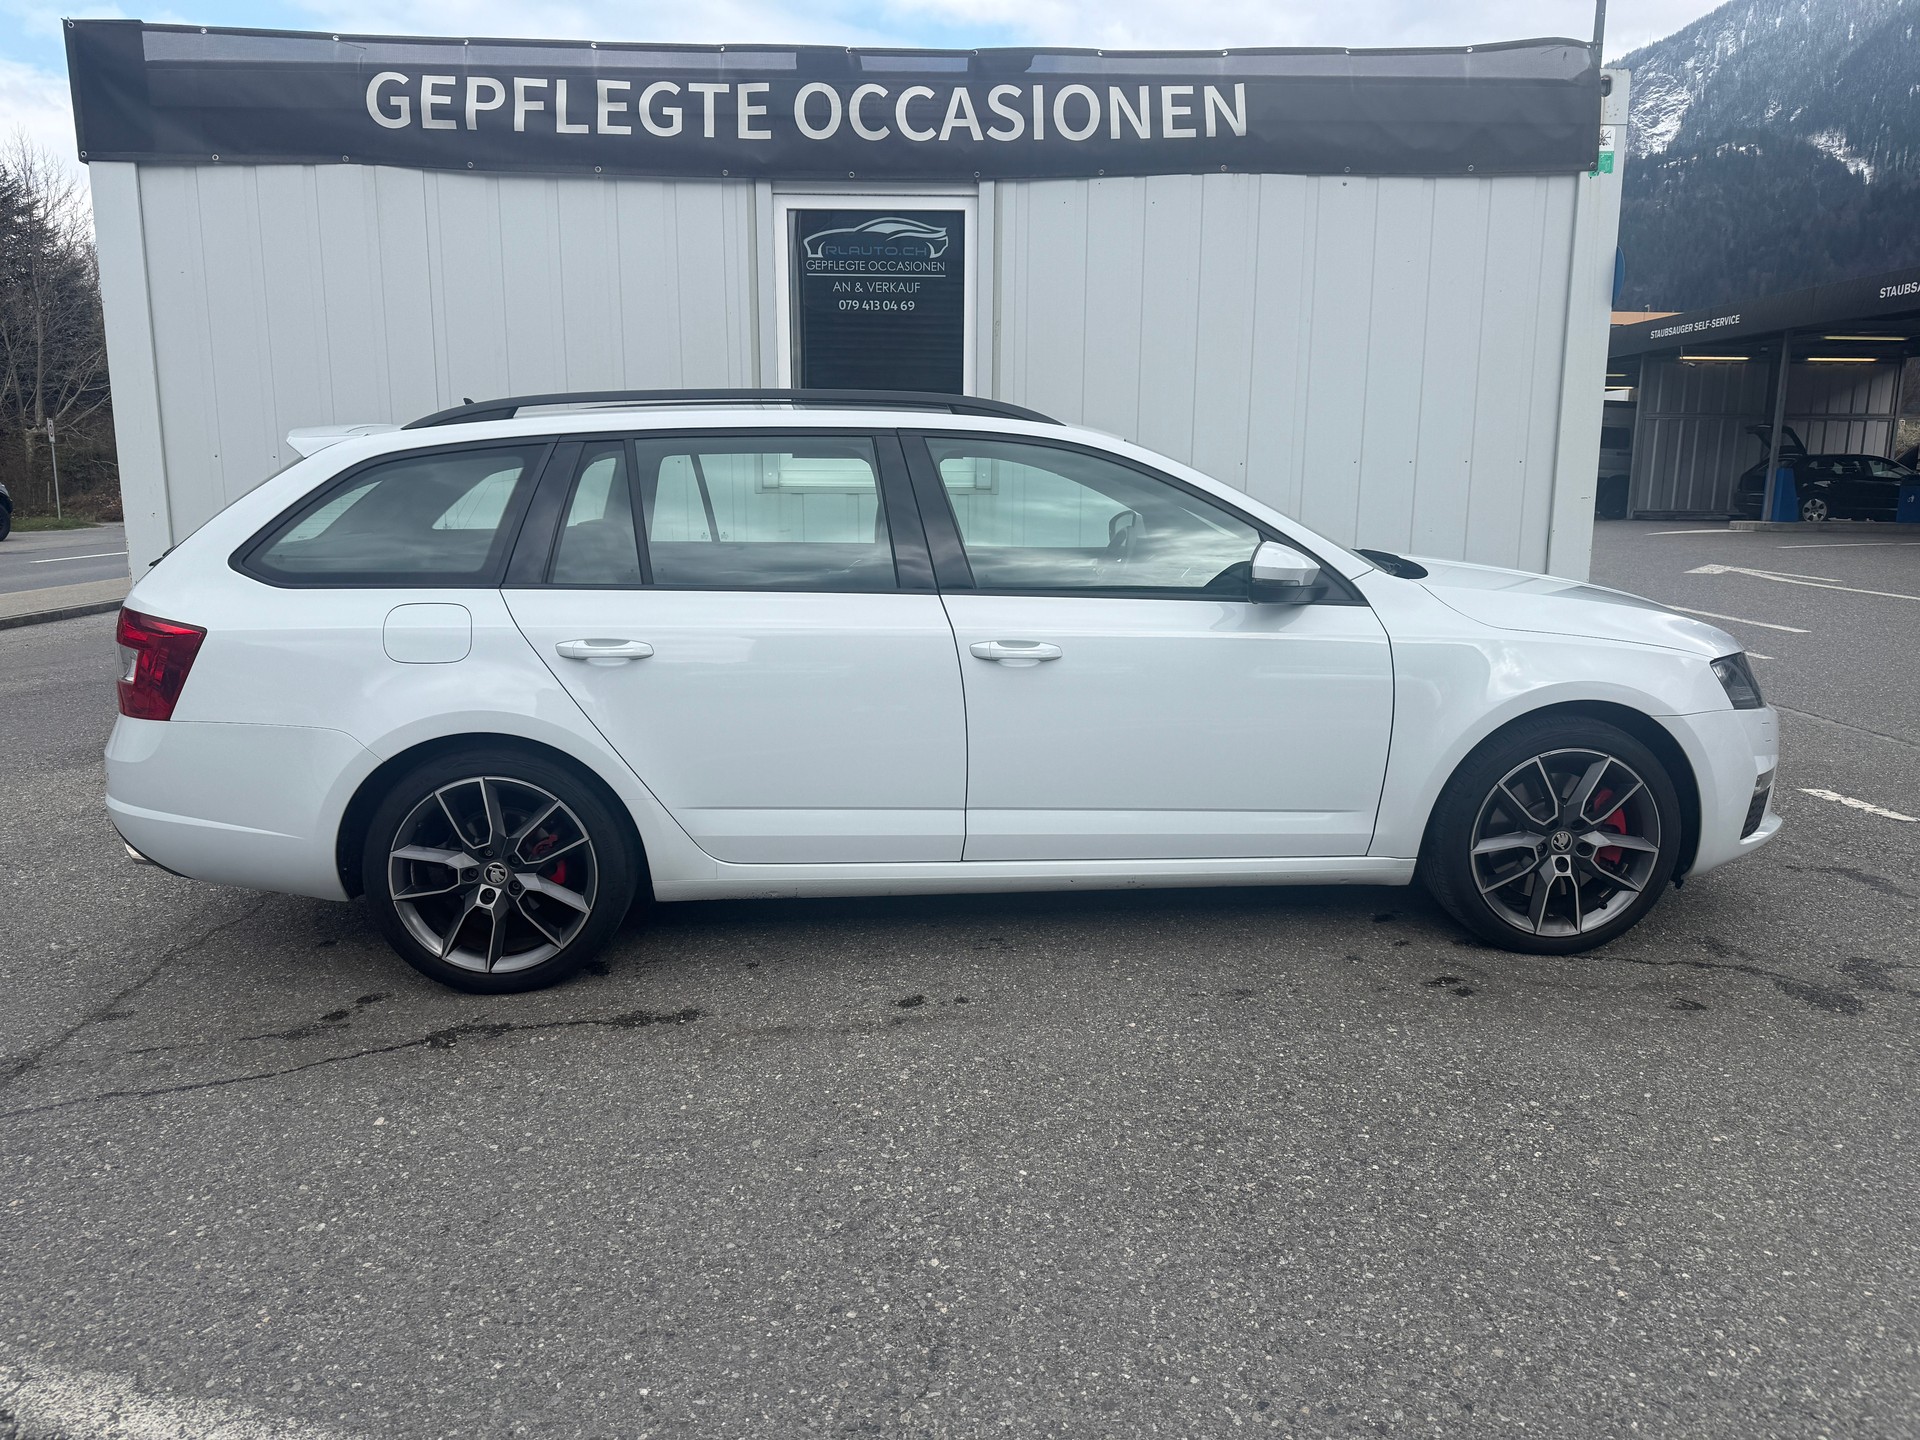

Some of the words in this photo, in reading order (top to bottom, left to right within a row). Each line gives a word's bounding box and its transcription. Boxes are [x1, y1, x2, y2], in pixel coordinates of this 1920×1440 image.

[365, 71, 772, 141] GEPFLEGTE
[794, 82, 1248, 143] OCCASIONEN
[825, 245, 927, 256] RLAUTO.CH
[805, 260, 866, 271] GEPFLEGTE
[868, 260, 945, 272] OCCASIONEN
[832, 281, 851, 293] AN
[854, 282, 864, 293] &
[866, 282, 921, 294] VERKAUF
[838, 300, 859, 311] 079
[861, 300, 880, 311] 413
[882, 300, 898, 311] 04
[900, 300, 915, 312] 69
[1650, 323, 1693, 339] STAUBSAUGER
[1694, 314, 1740, 331] SELF-SERVICE
